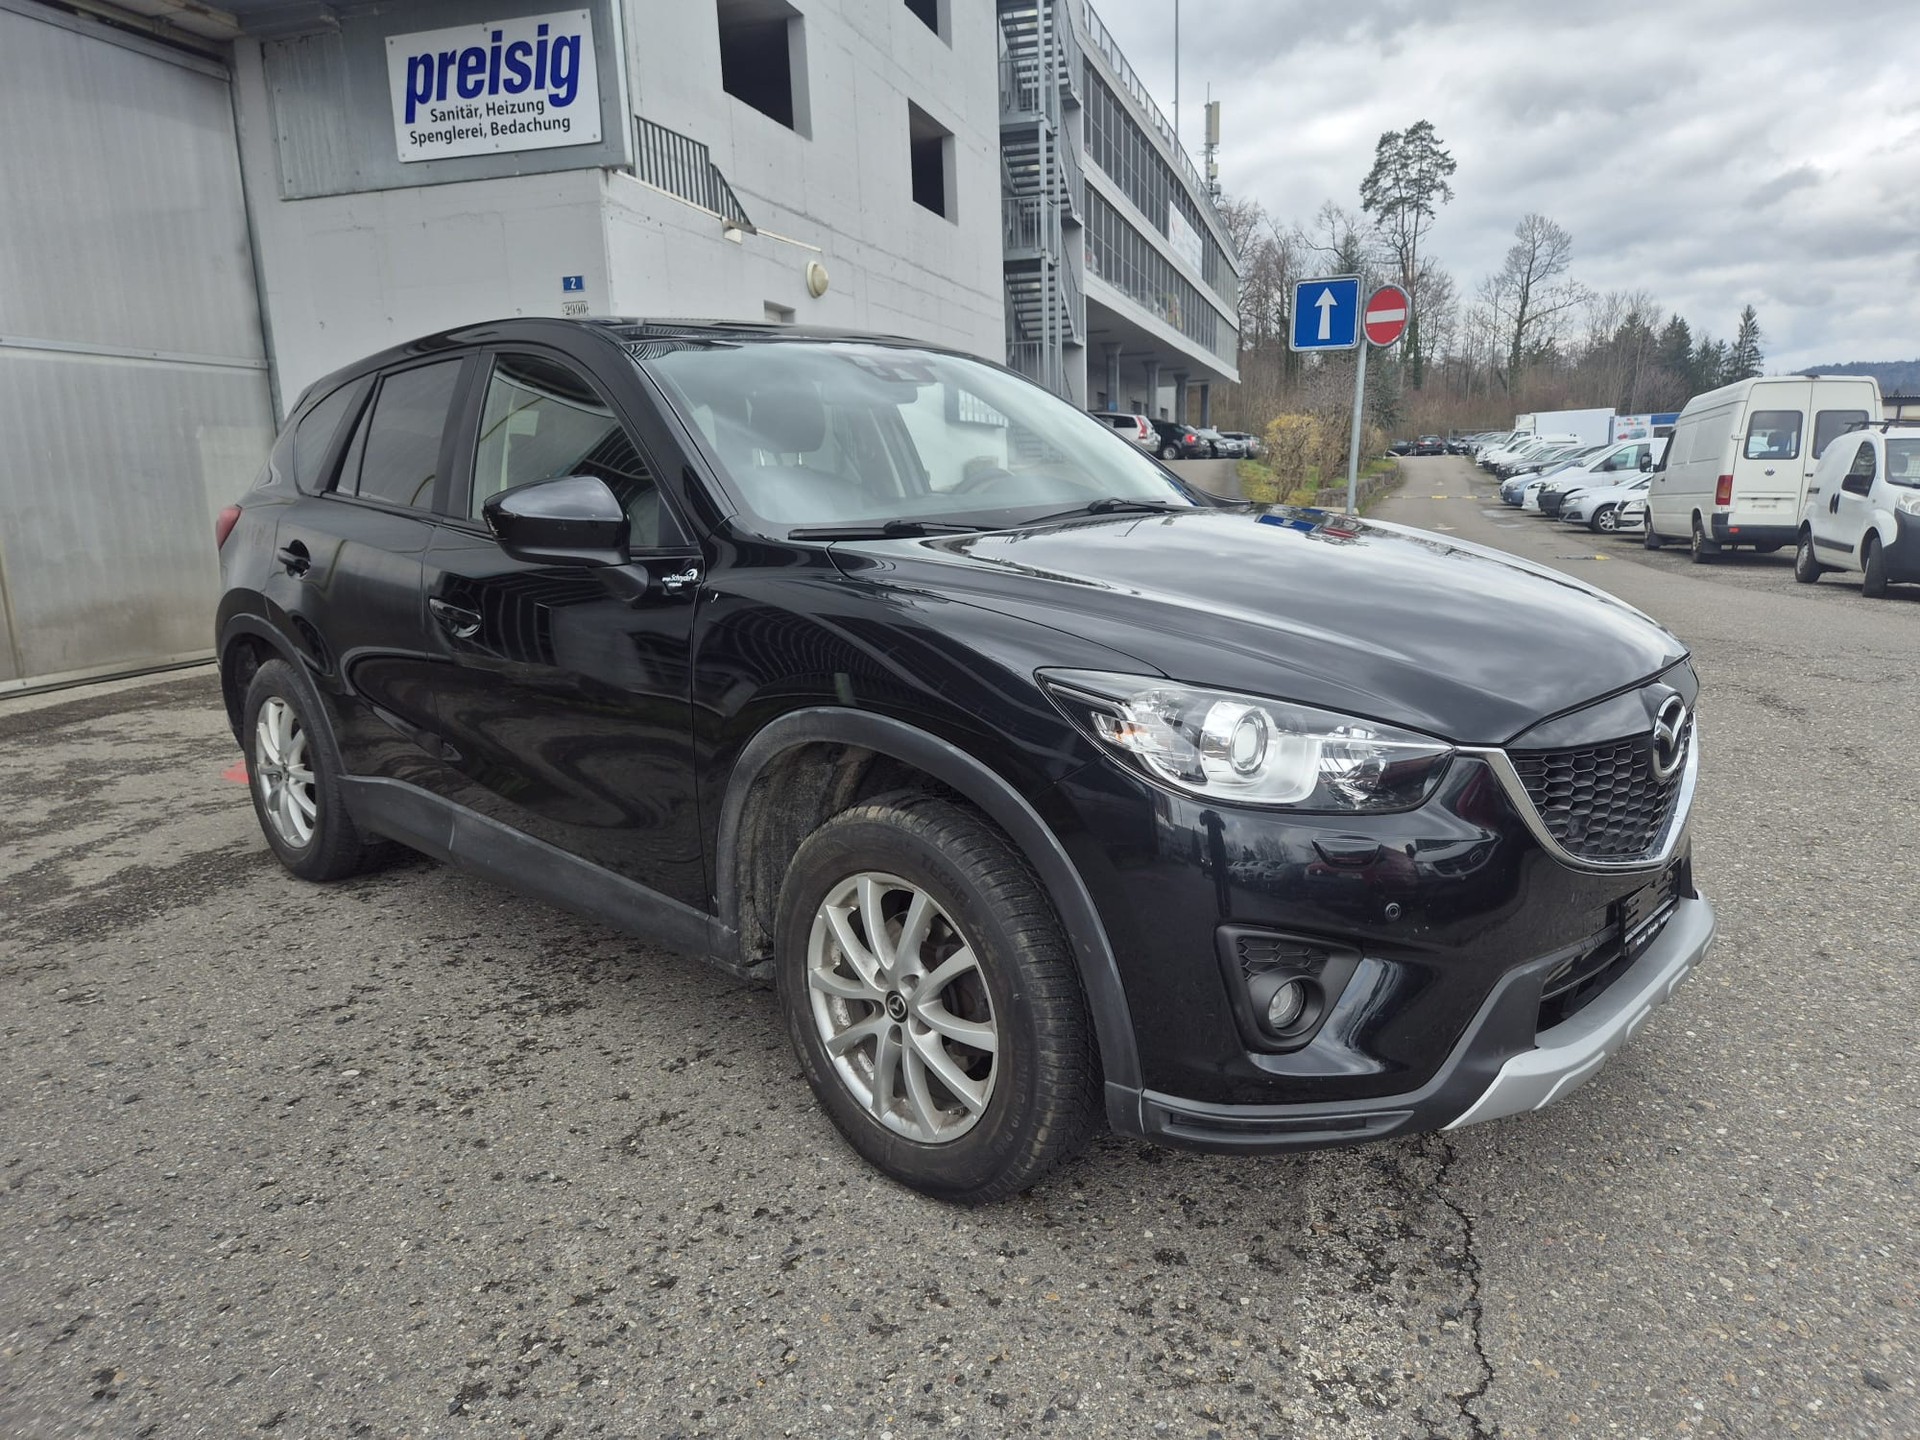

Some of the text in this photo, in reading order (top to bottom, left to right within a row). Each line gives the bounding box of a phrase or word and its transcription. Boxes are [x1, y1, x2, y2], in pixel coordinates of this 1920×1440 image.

[405, 23, 581, 124] preisig
[430, 100, 545, 123] Sanitär, Heizung
[410, 116, 571, 147] Spenglerei, Bedachung
[570, 277, 577, 289] 2
